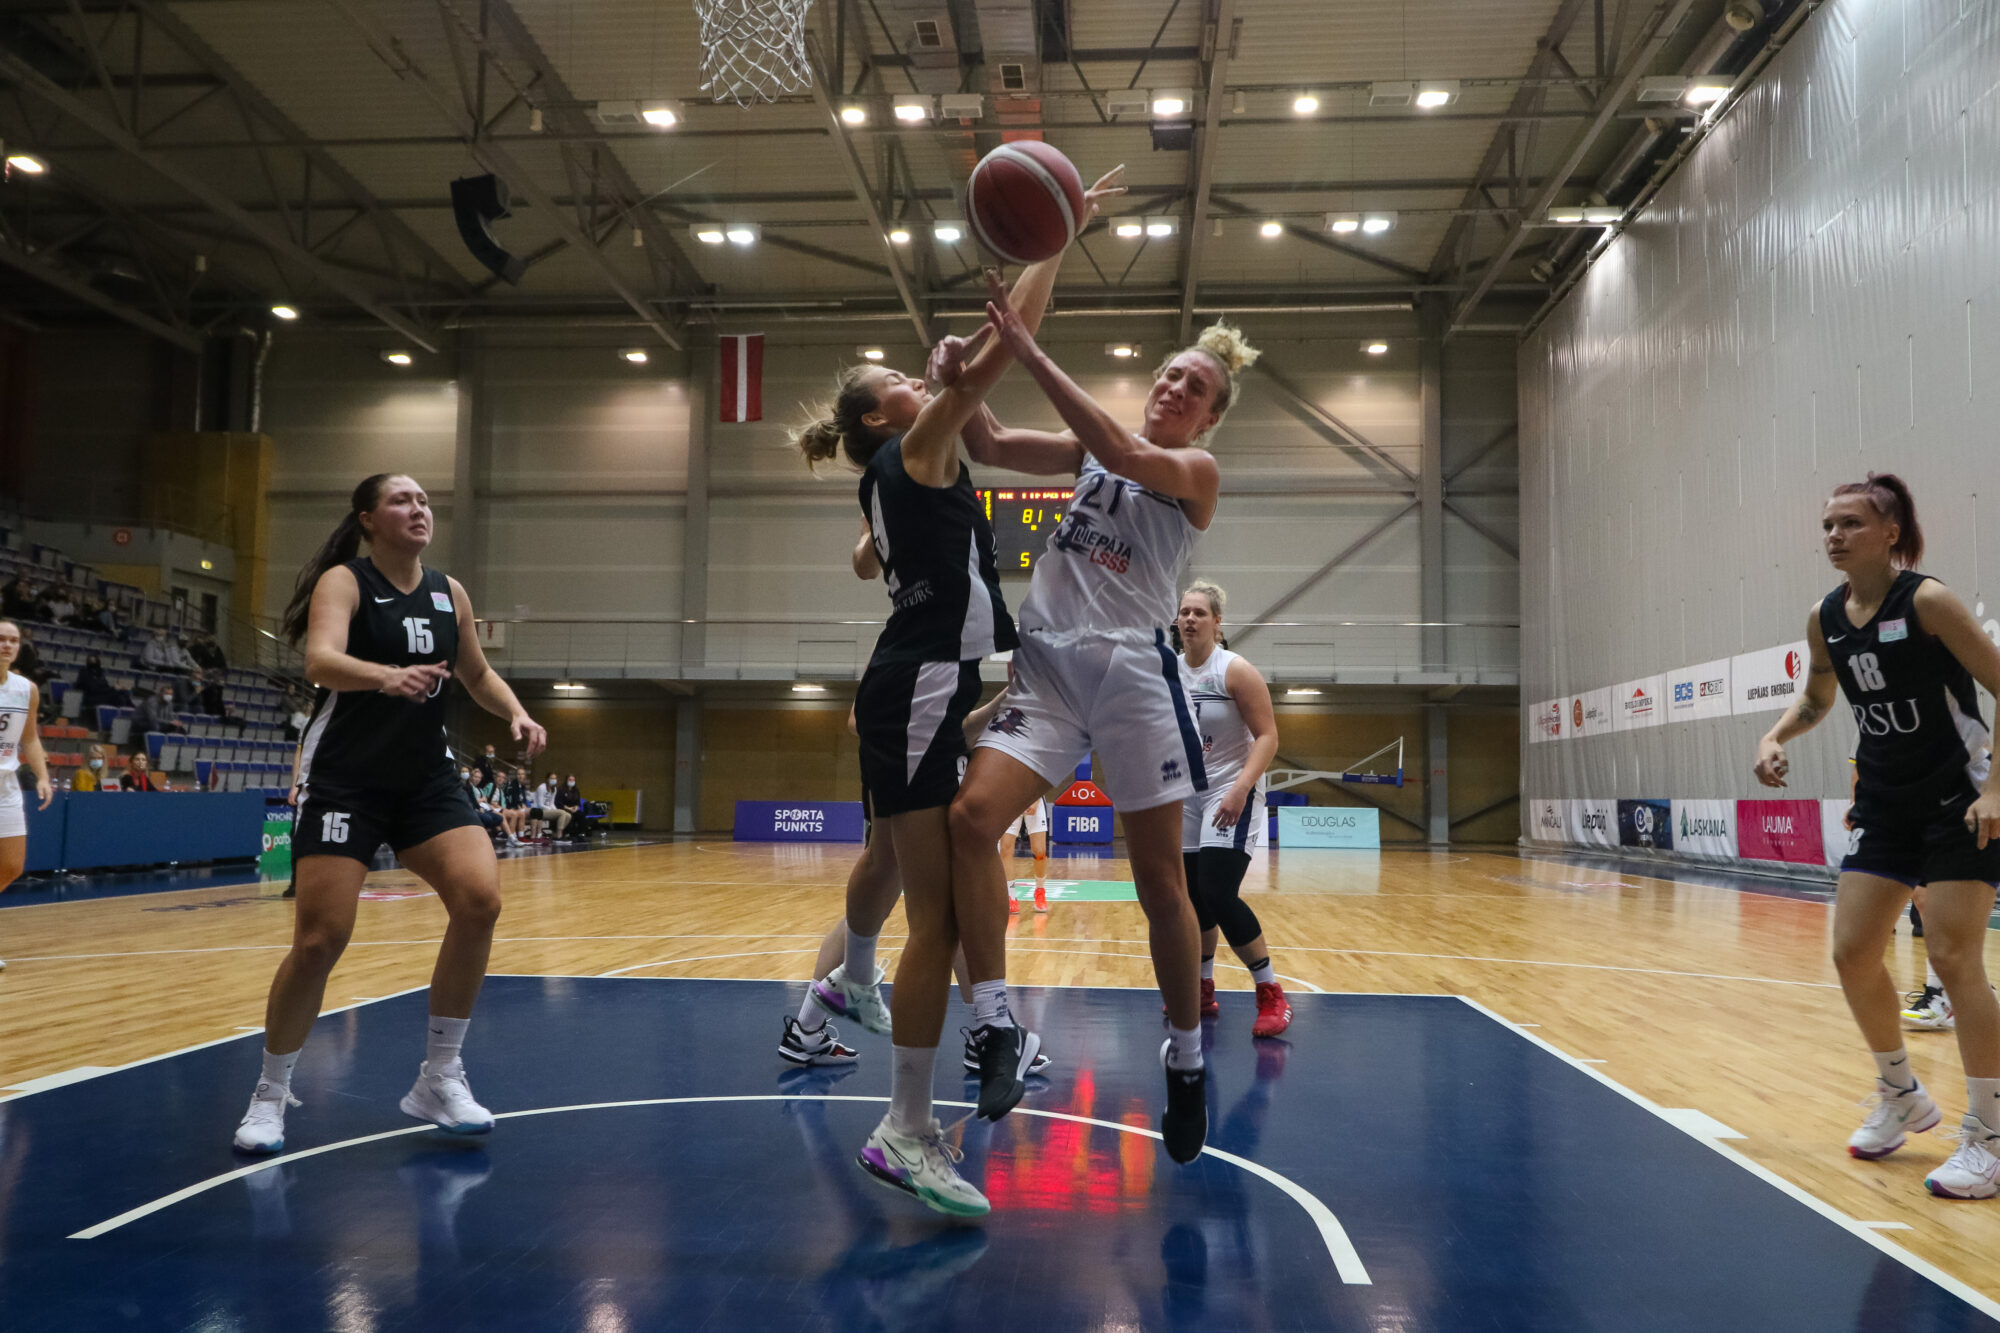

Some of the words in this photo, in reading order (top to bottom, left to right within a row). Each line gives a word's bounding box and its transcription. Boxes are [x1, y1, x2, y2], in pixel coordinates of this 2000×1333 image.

[1080, 472, 1126, 517] 21
[1089, 548, 1130, 574] LSSS
[402, 617, 434, 655] 15
[1848, 652, 1886, 692] 18
[1852, 698, 1920, 736] RSU
[1072, 788, 1095, 799] LOC
[774, 809, 824, 820] SPORTA
[1301, 816, 1356, 828] DOUGLAS
[321, 812, 351, 843] 15
[774, 821, 823, 832] PUNKTS
[1068, 817, 1099, 832] FIBA
[1689, 819, 1727, 837] LASKANA
[1762, 816, 1793, 834] LAUMA
